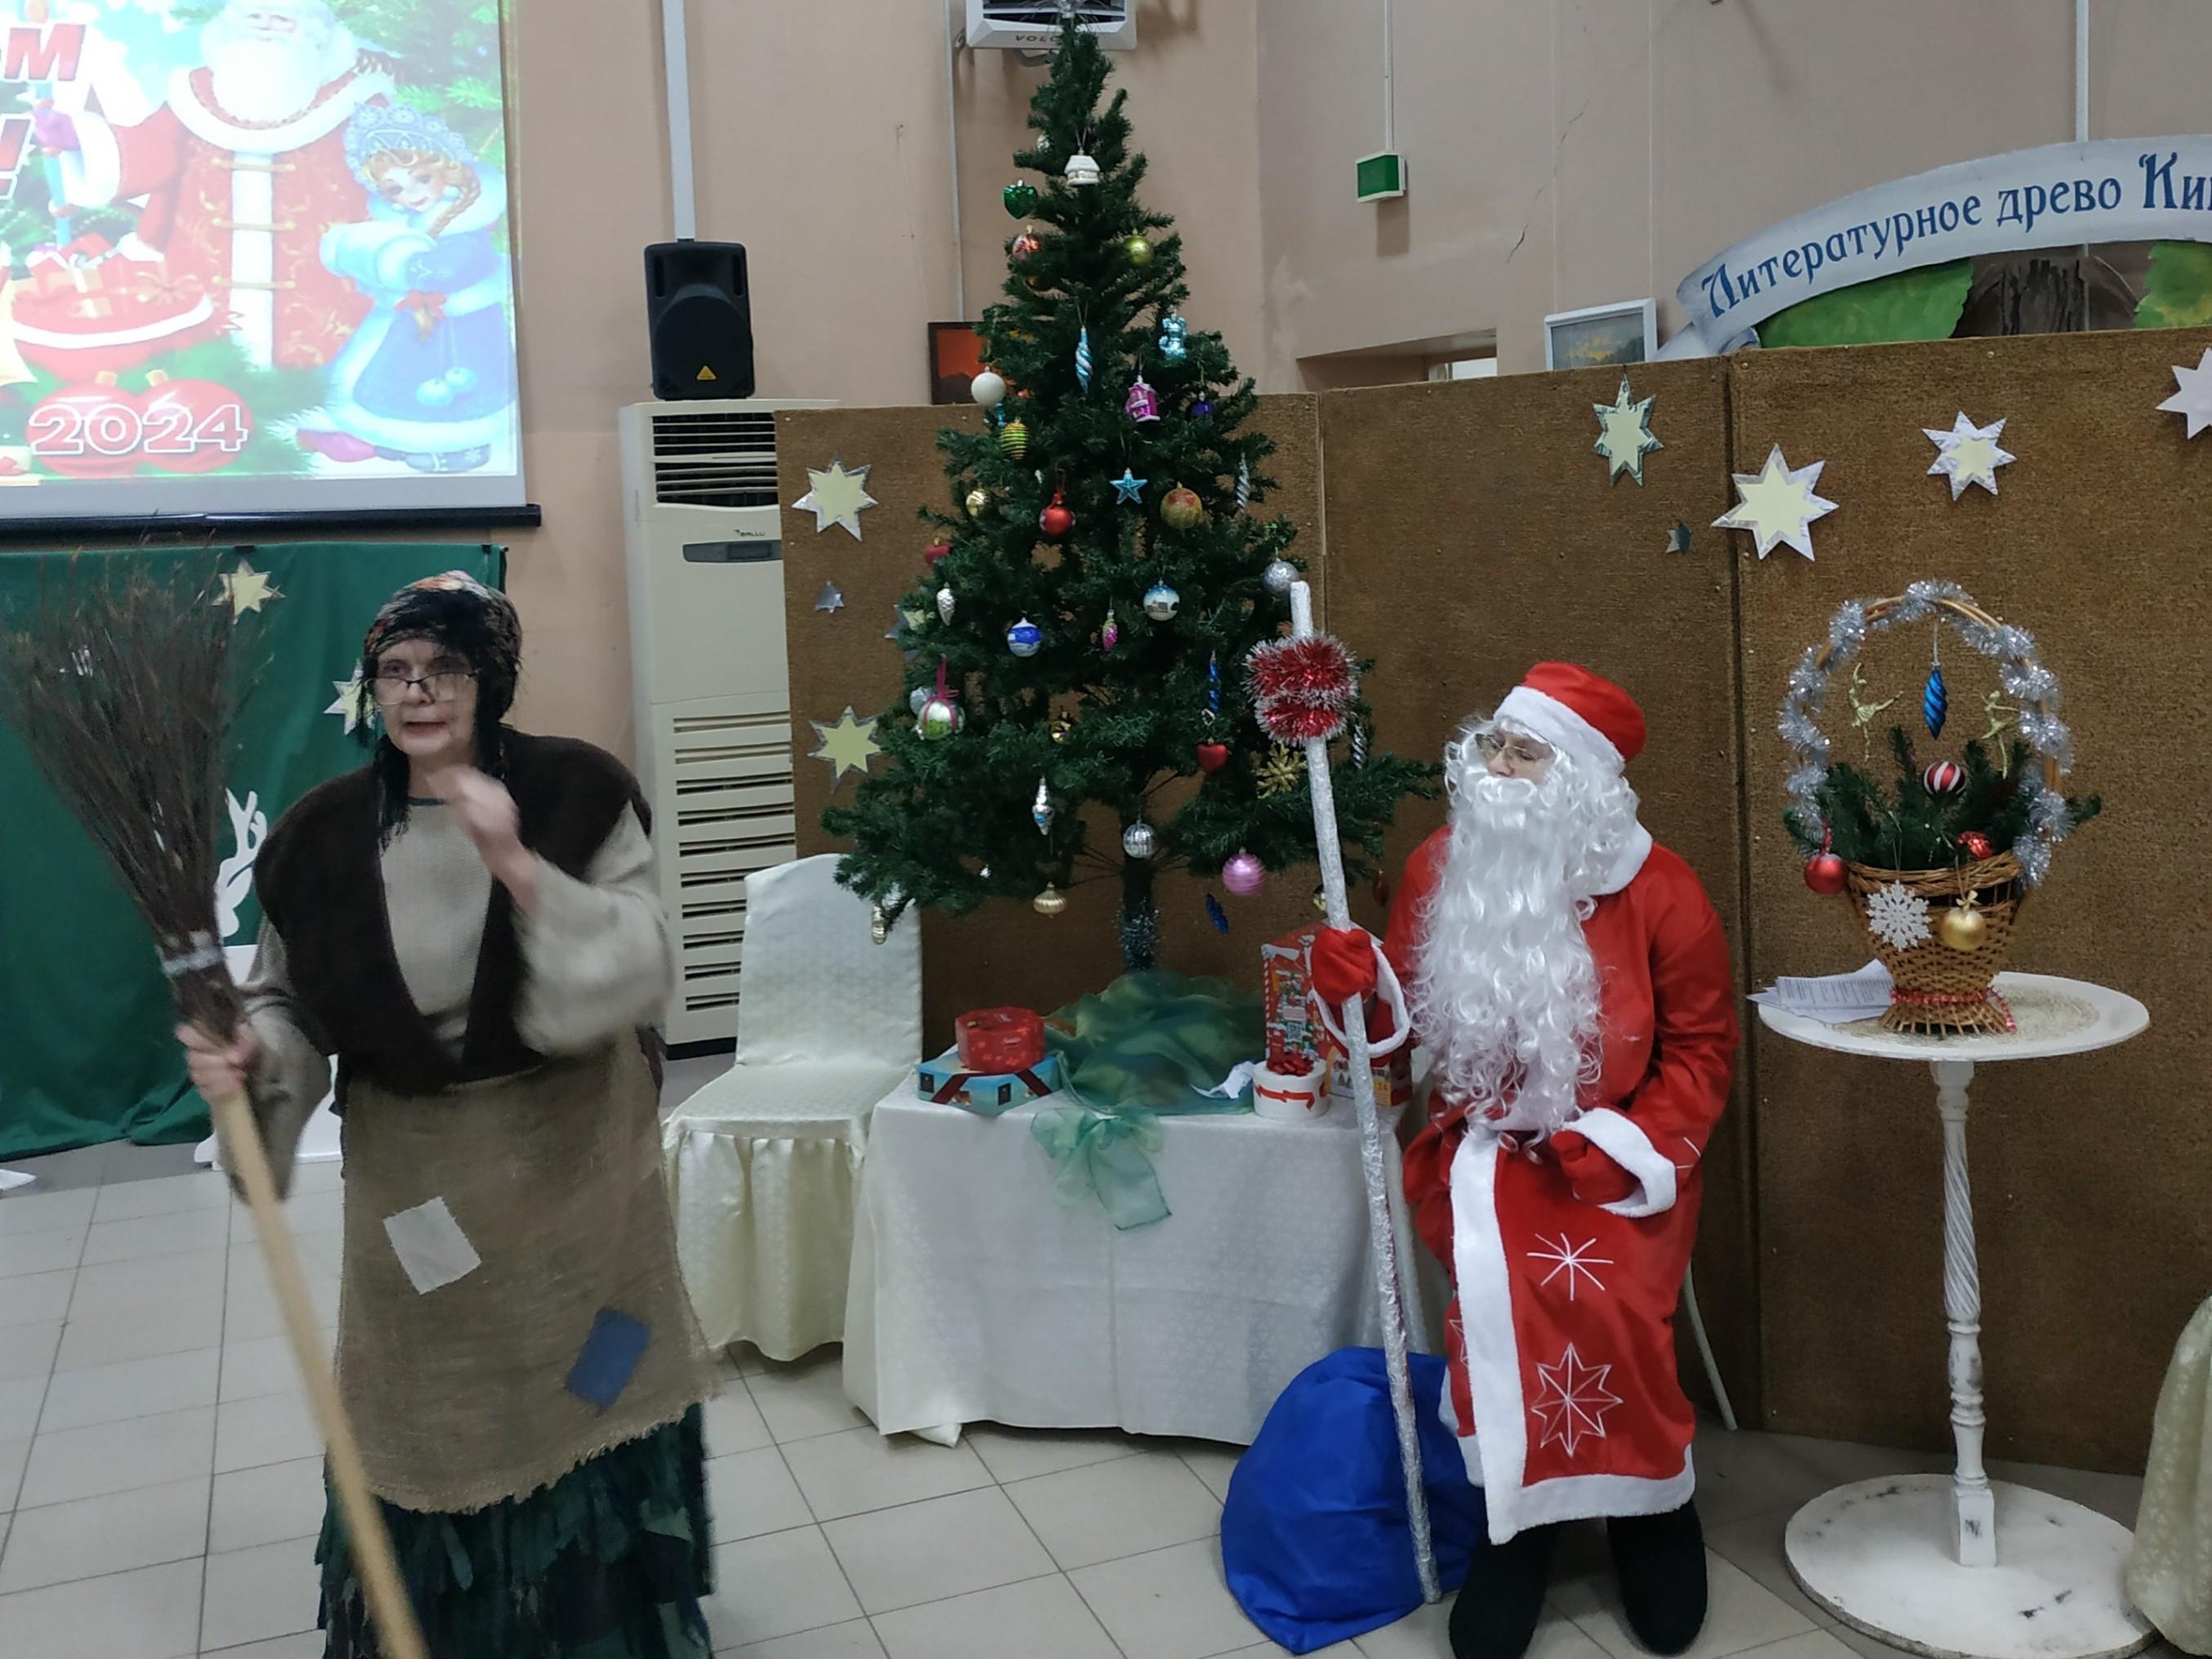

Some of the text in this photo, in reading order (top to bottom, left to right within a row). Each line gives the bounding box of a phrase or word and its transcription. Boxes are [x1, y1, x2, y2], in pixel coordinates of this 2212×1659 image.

[1700, 151, 2212, 318] Литературное древо Ки
[28, 403, 248, 455] 2024
